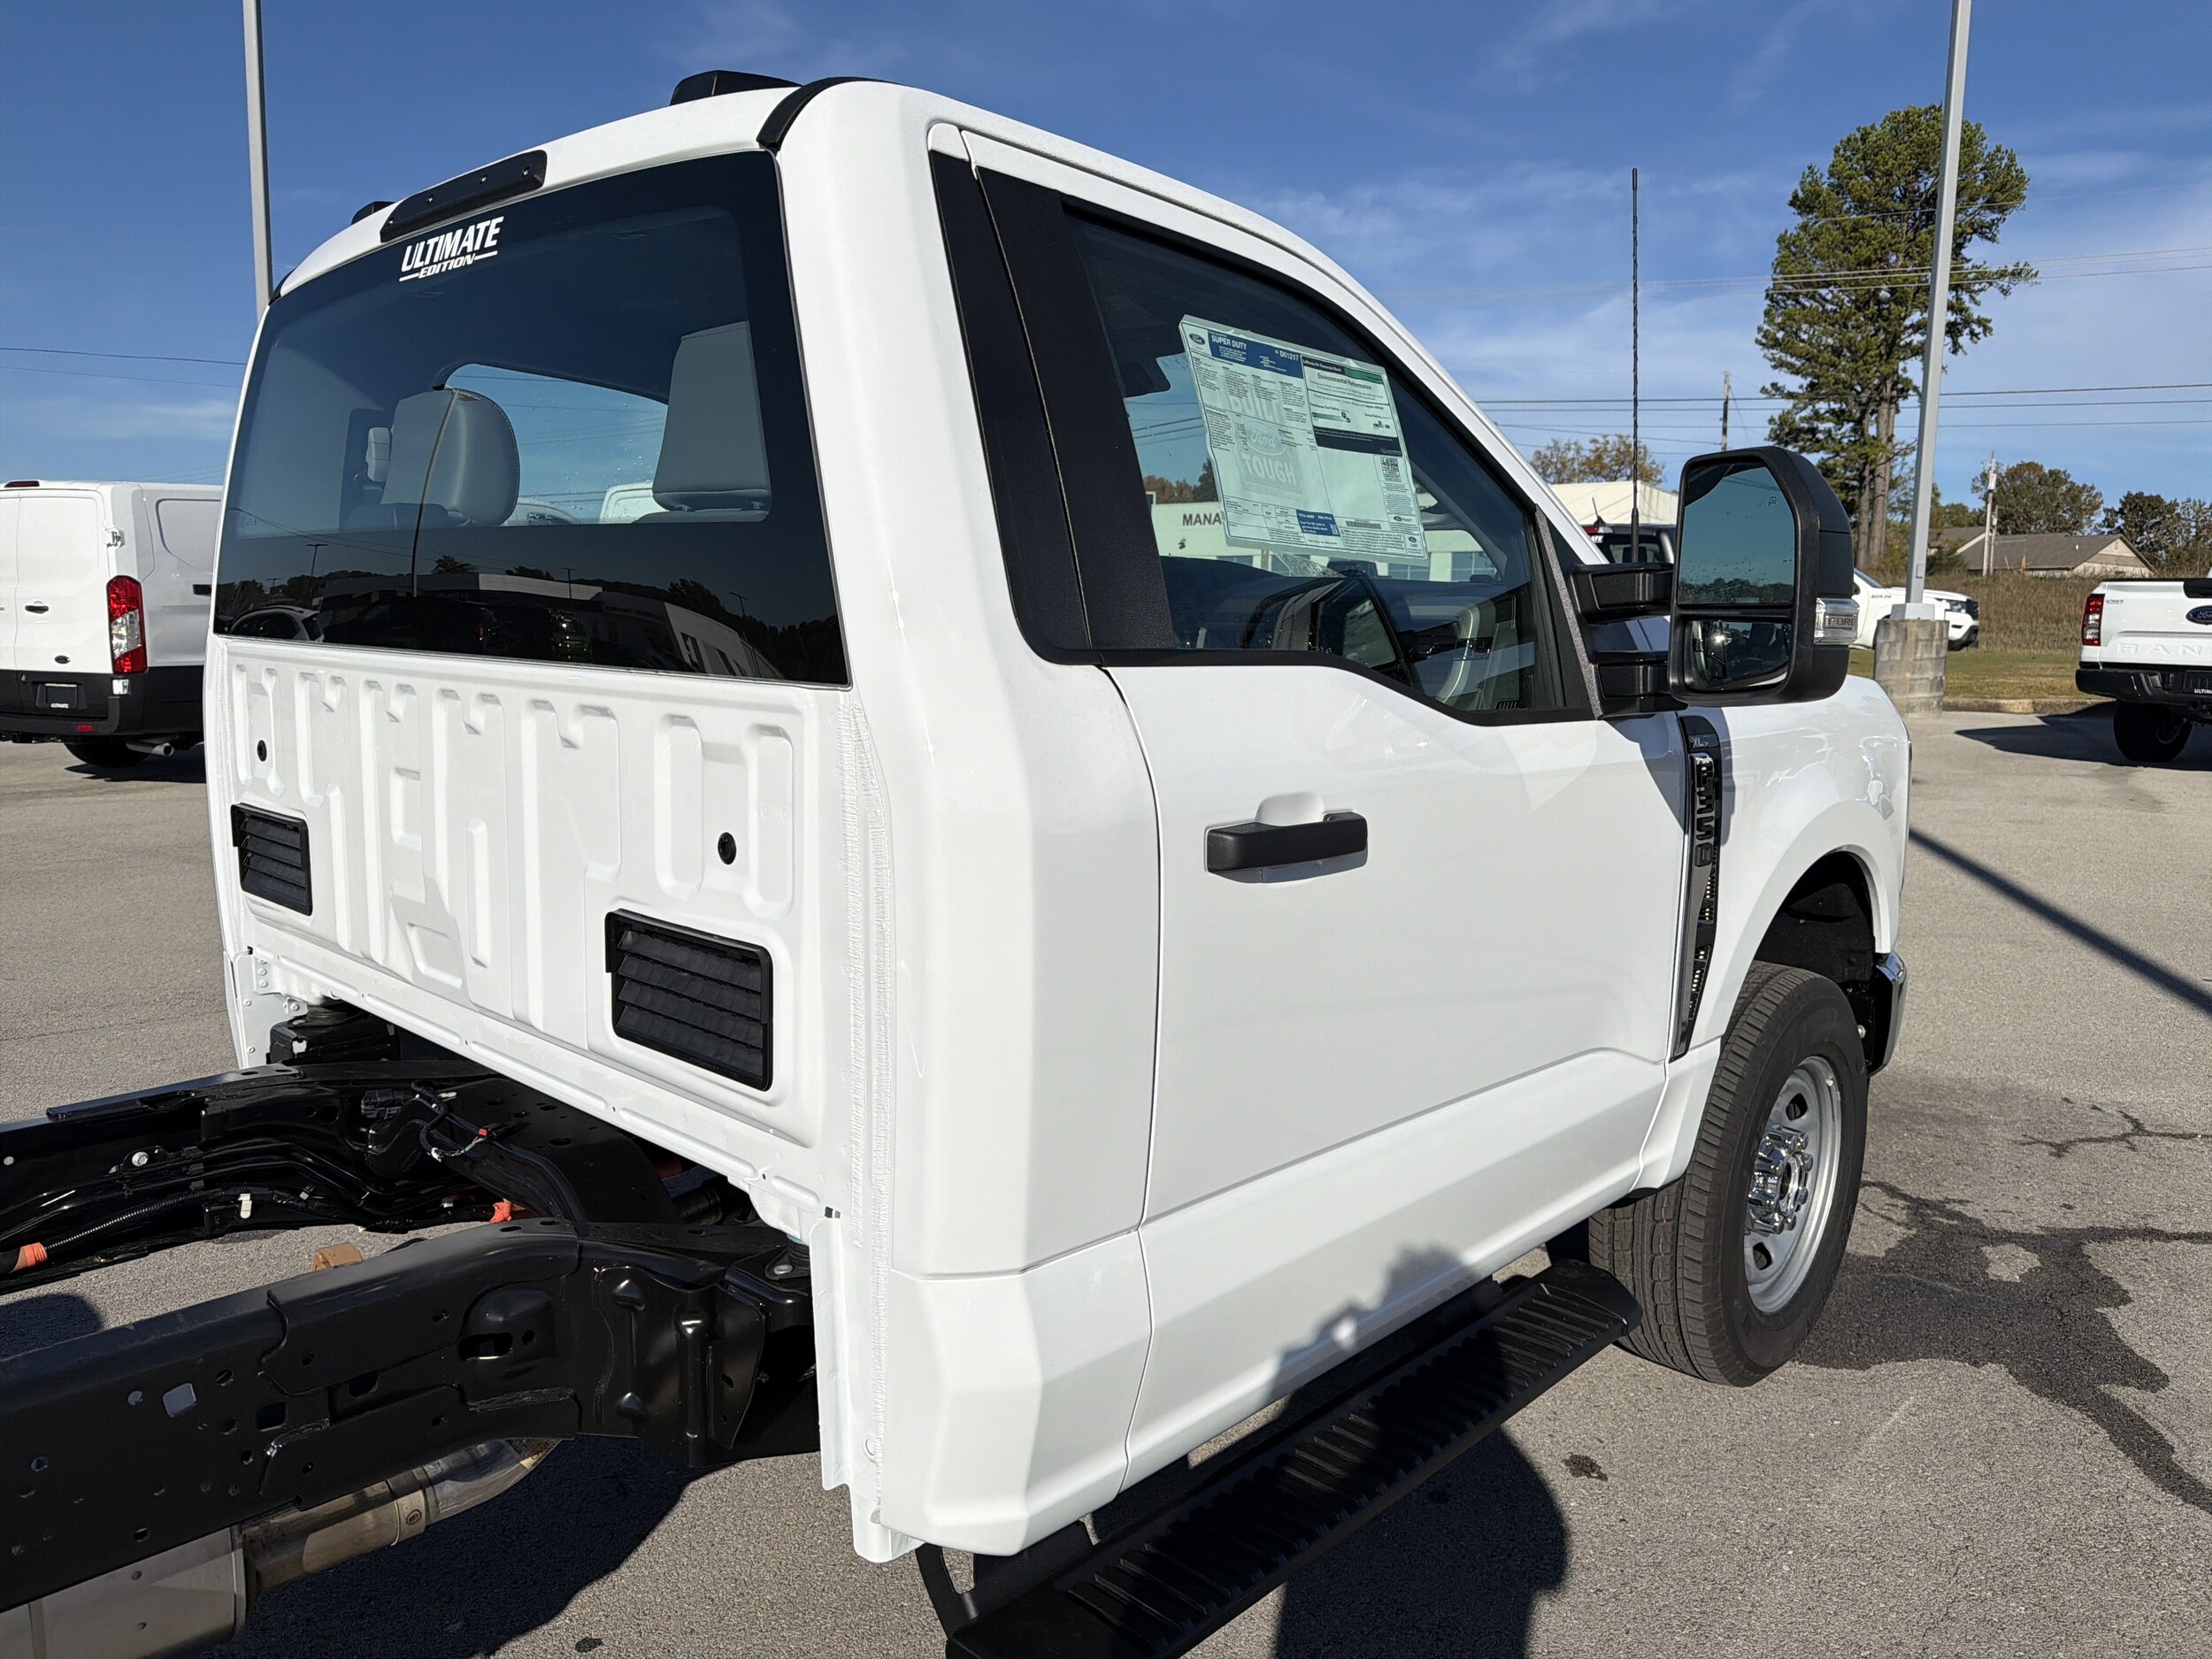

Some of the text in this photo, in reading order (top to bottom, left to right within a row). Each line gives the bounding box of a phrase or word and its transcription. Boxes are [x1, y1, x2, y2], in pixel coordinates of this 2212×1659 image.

[401, 216, 504, 273] ULTIMATE
[419, 253, 475, 279] EDITION
[1211, 335, 1248, 350] SUPER DUTY
[1240, 452, 1296, 486] TOUGH
[1182, 513, 1222, 526] MANA
